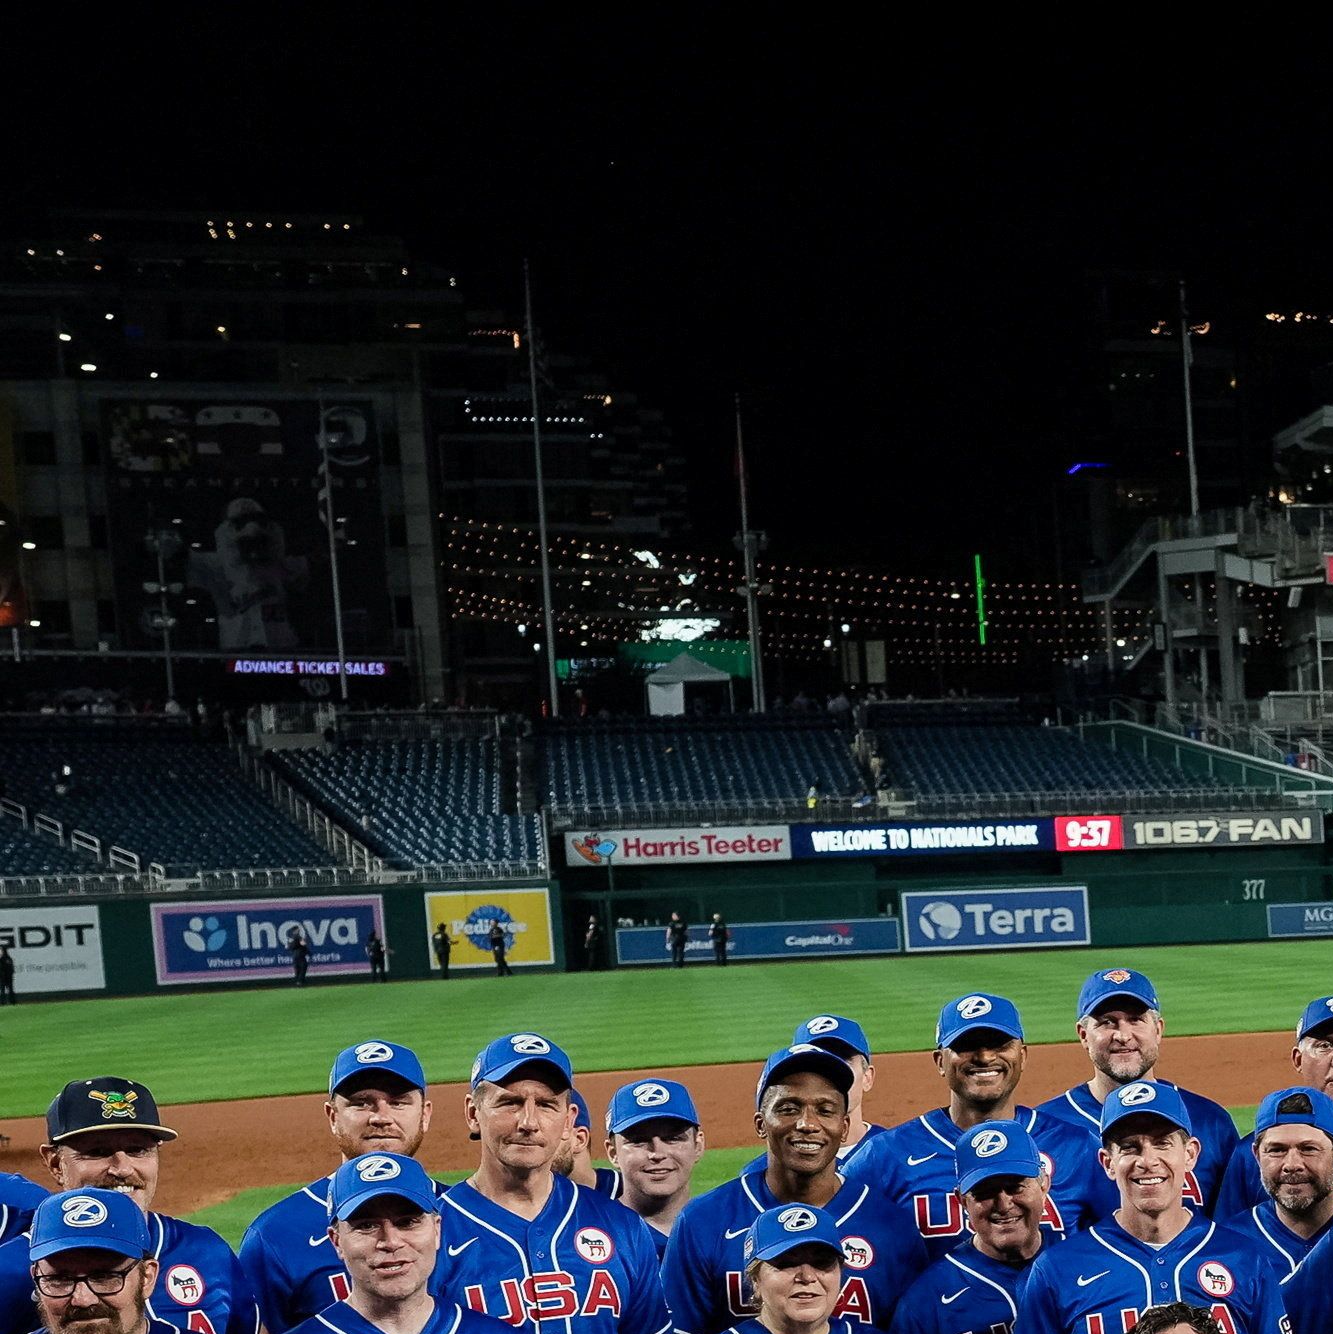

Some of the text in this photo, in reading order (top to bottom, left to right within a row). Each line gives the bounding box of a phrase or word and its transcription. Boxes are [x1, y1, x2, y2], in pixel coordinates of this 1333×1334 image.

[234, 660, 386, 675] ADVANCE TICKET SALES
[812, 824, 1038, 852] WELCOME TO NATIONALS PARK
[1065, 820, 1111, 847] 9:37
[1134, 817, 1311, 845] 106.7 FAN
[623, 834, 783, 859] Harris Teeter
[1242, 879, 1266, 901] 377
[237, 914, 358, 950] Inova
[451, 918, 528, 935] Pediree
[962, 901, 1075, 936] Terra
[207, 956, 241, 968] Where
[243, 956, 275, 967] better
[464, 1268, 623, 1329] USA
